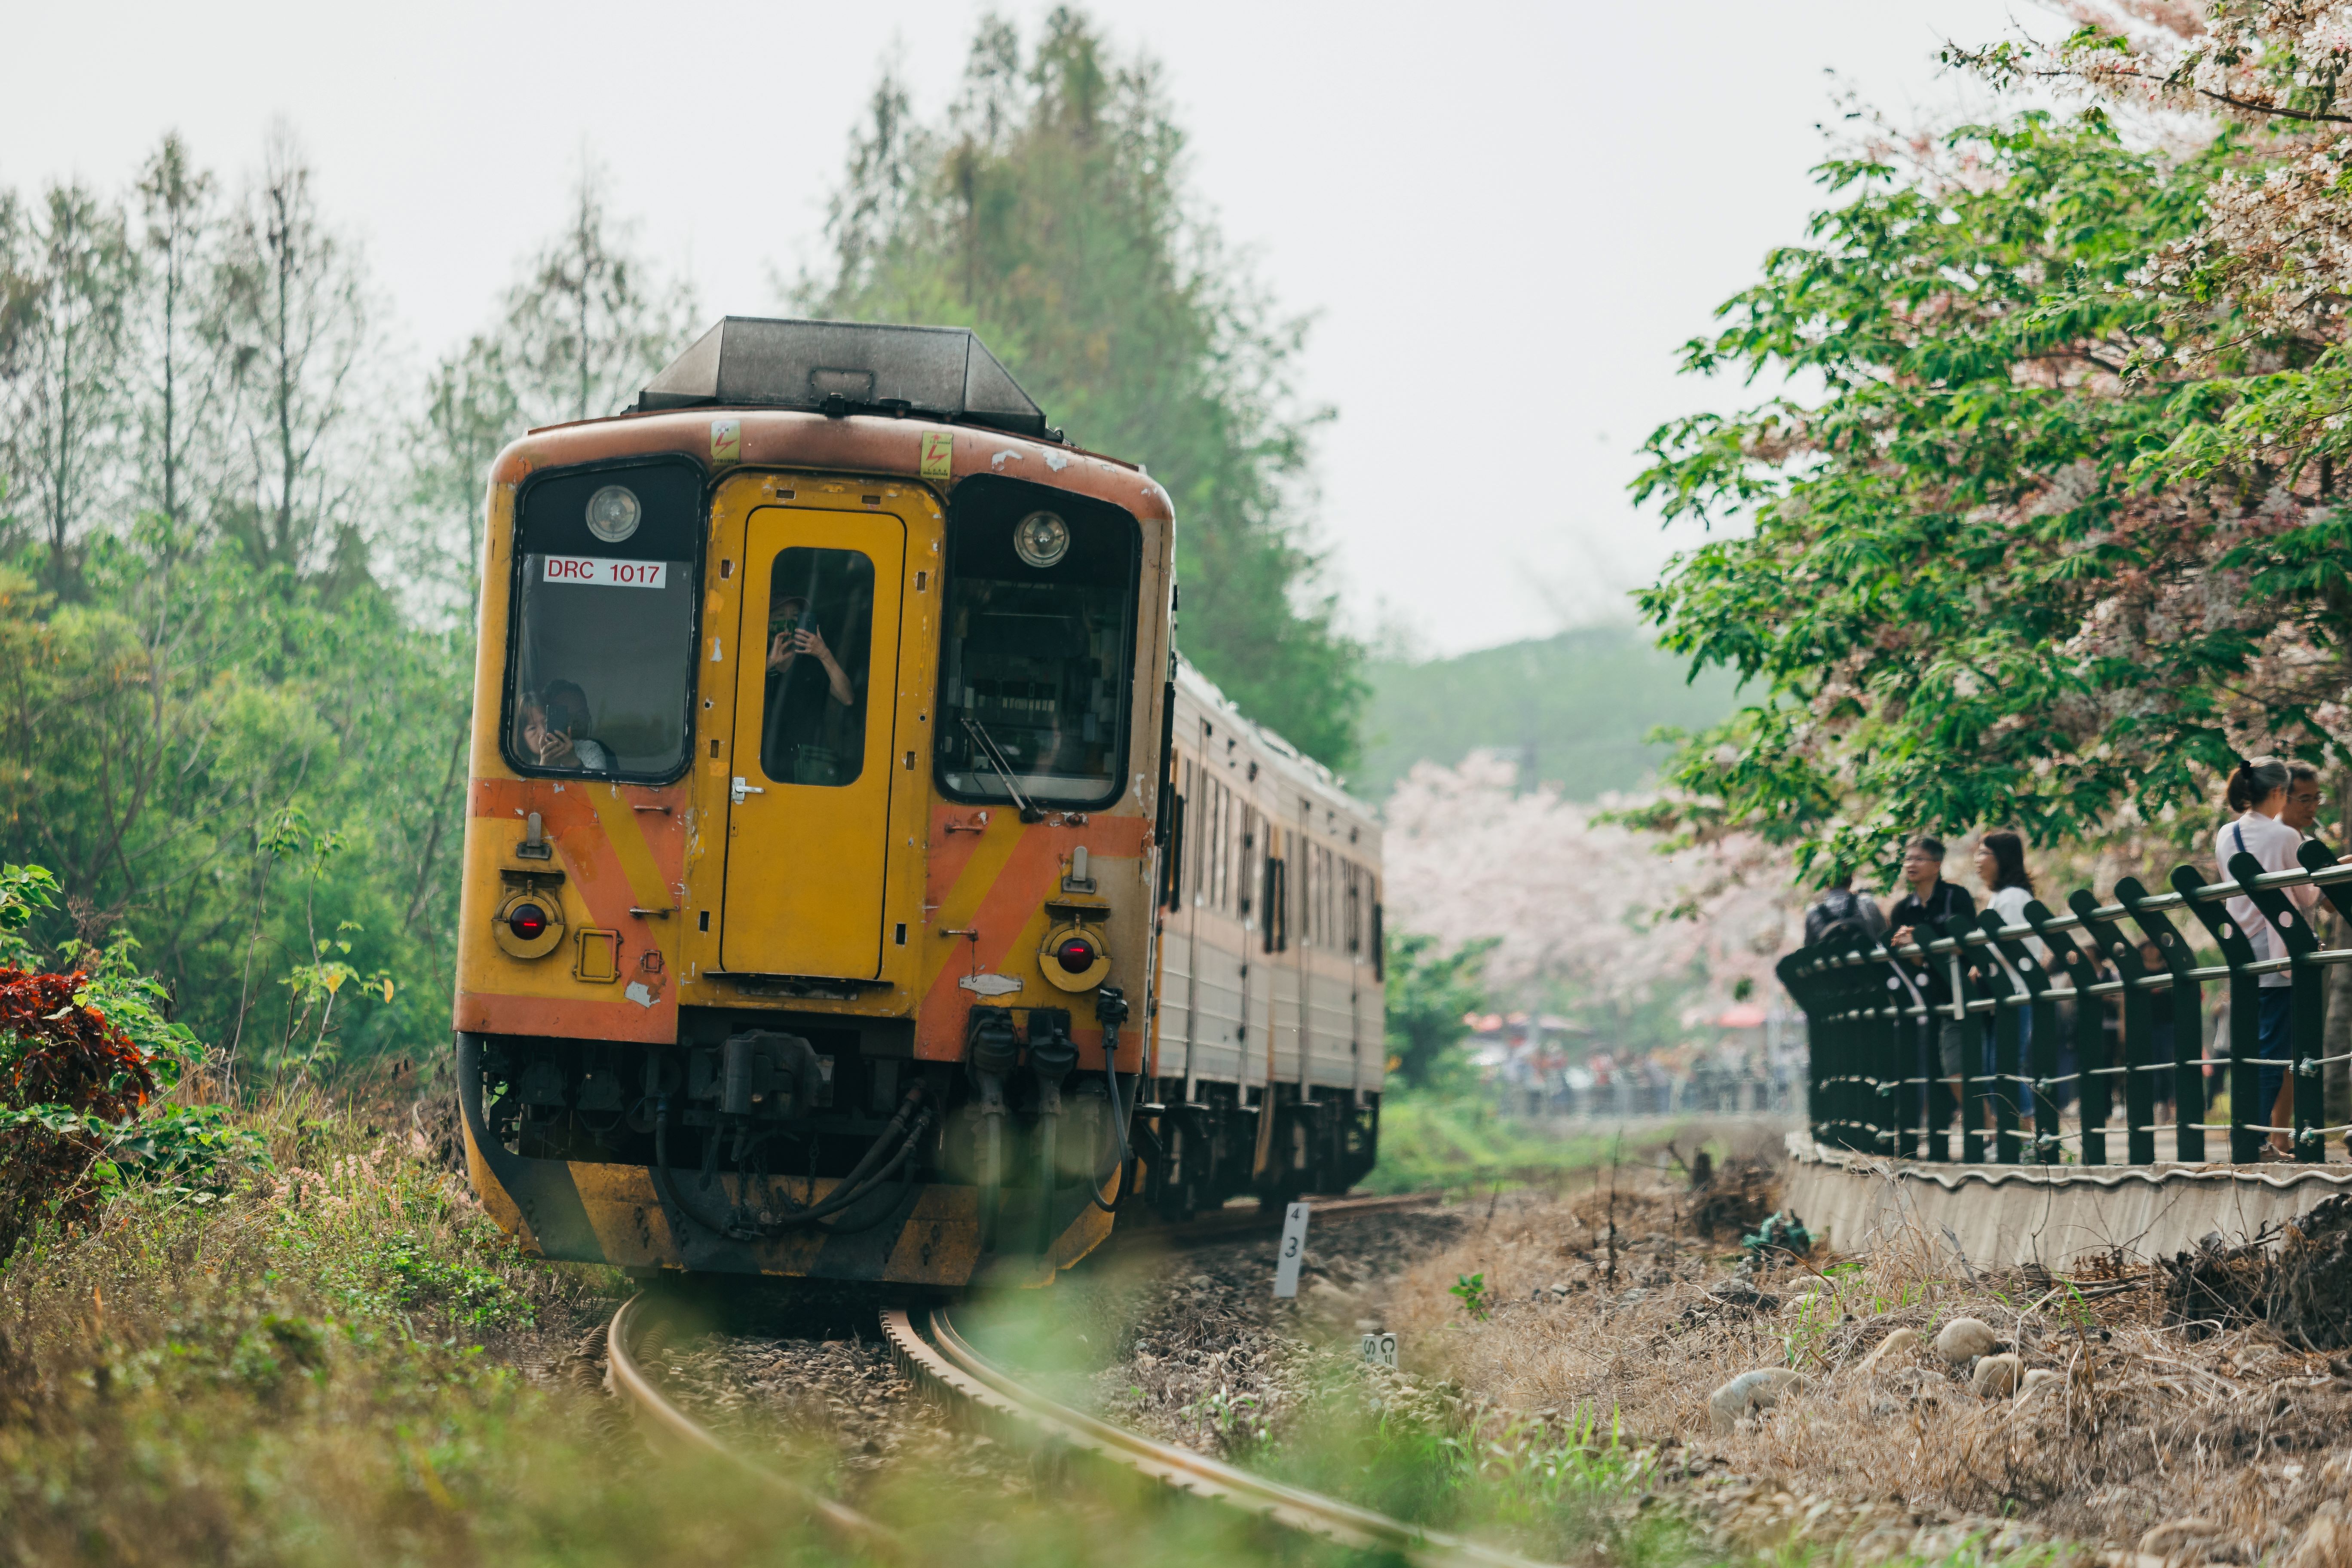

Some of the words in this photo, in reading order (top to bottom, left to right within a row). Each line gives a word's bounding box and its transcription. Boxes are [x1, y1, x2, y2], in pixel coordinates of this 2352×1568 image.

[548, 560, 594, 579] DRC
[610, 564, 660, 583] 1017
[1291, 1207, 1299, 1221] 4
[1285, 1236, 1298, 1258] 3
